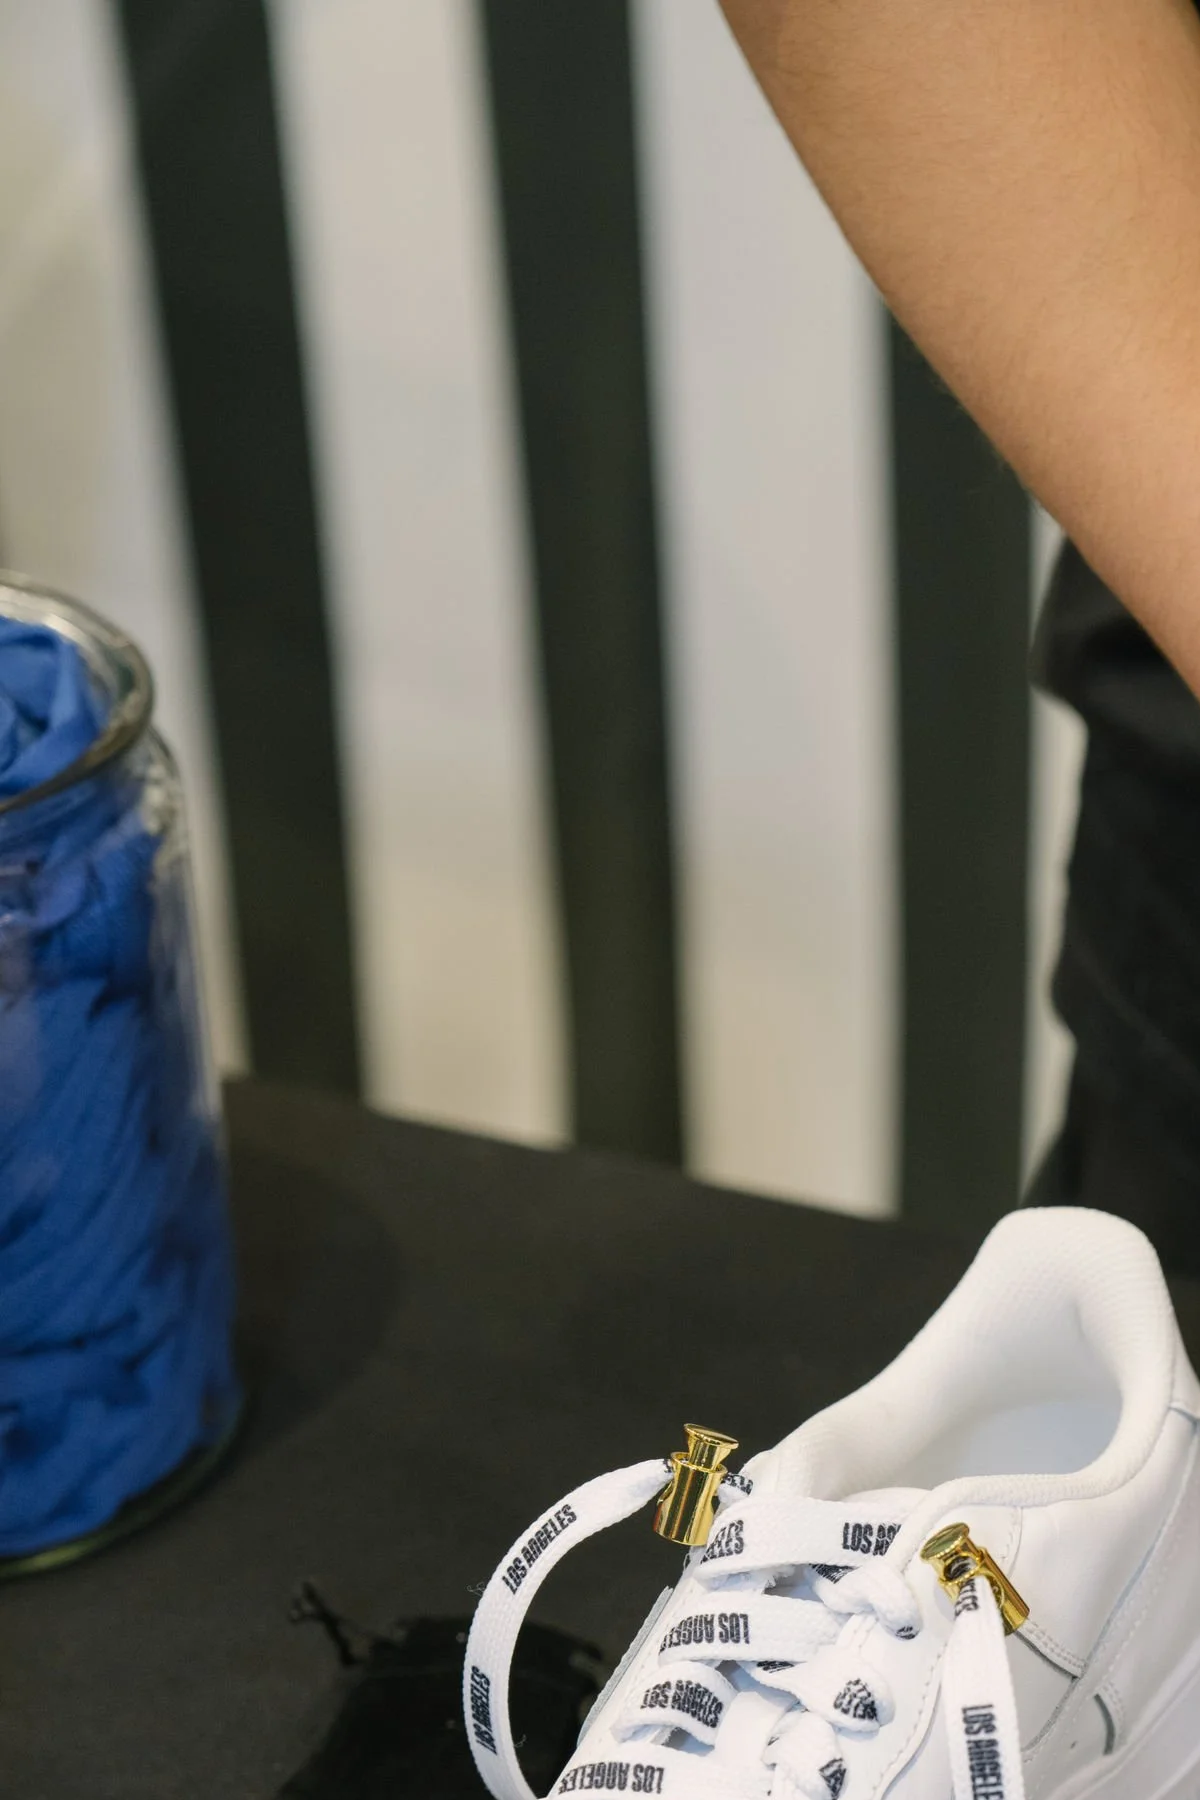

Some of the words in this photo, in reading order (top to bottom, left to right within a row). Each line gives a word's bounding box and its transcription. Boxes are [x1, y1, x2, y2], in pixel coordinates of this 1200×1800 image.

[502, 1556, 527, 1595] LOS
[521, 1504, 578, 1569] ANGELES
[842, 1522, 873, 1554] LOS
[718, 1613, 750, 1645] LOS
[640, 1681, 671, 1710] LOS
[962, 1704, 997, 1735] LOS
[632, 1763, 664, 1795] LOS
